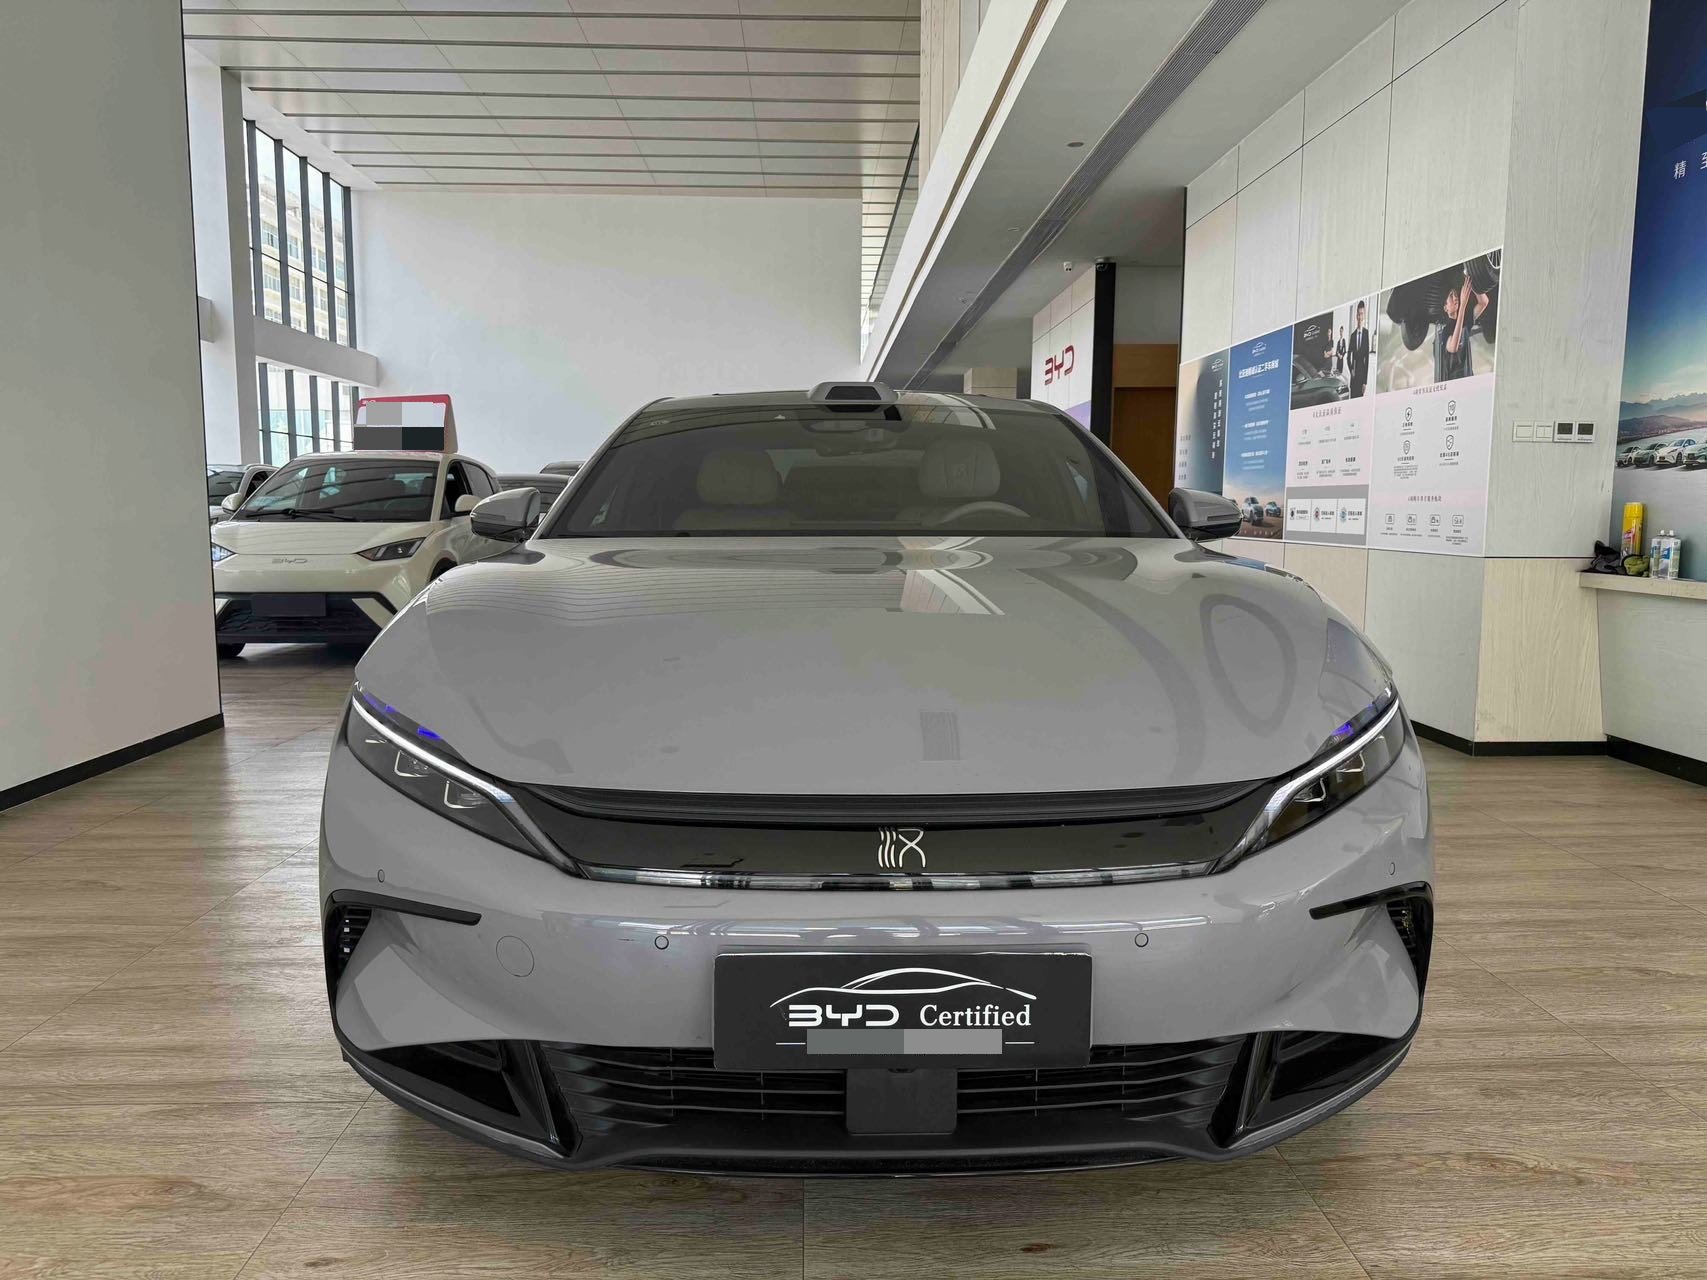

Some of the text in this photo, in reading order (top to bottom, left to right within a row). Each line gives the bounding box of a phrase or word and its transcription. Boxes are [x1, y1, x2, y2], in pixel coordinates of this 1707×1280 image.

[1045, 345, 1075, 386] BYD
[788, 1004, 1032, 1027] BYD Certified
